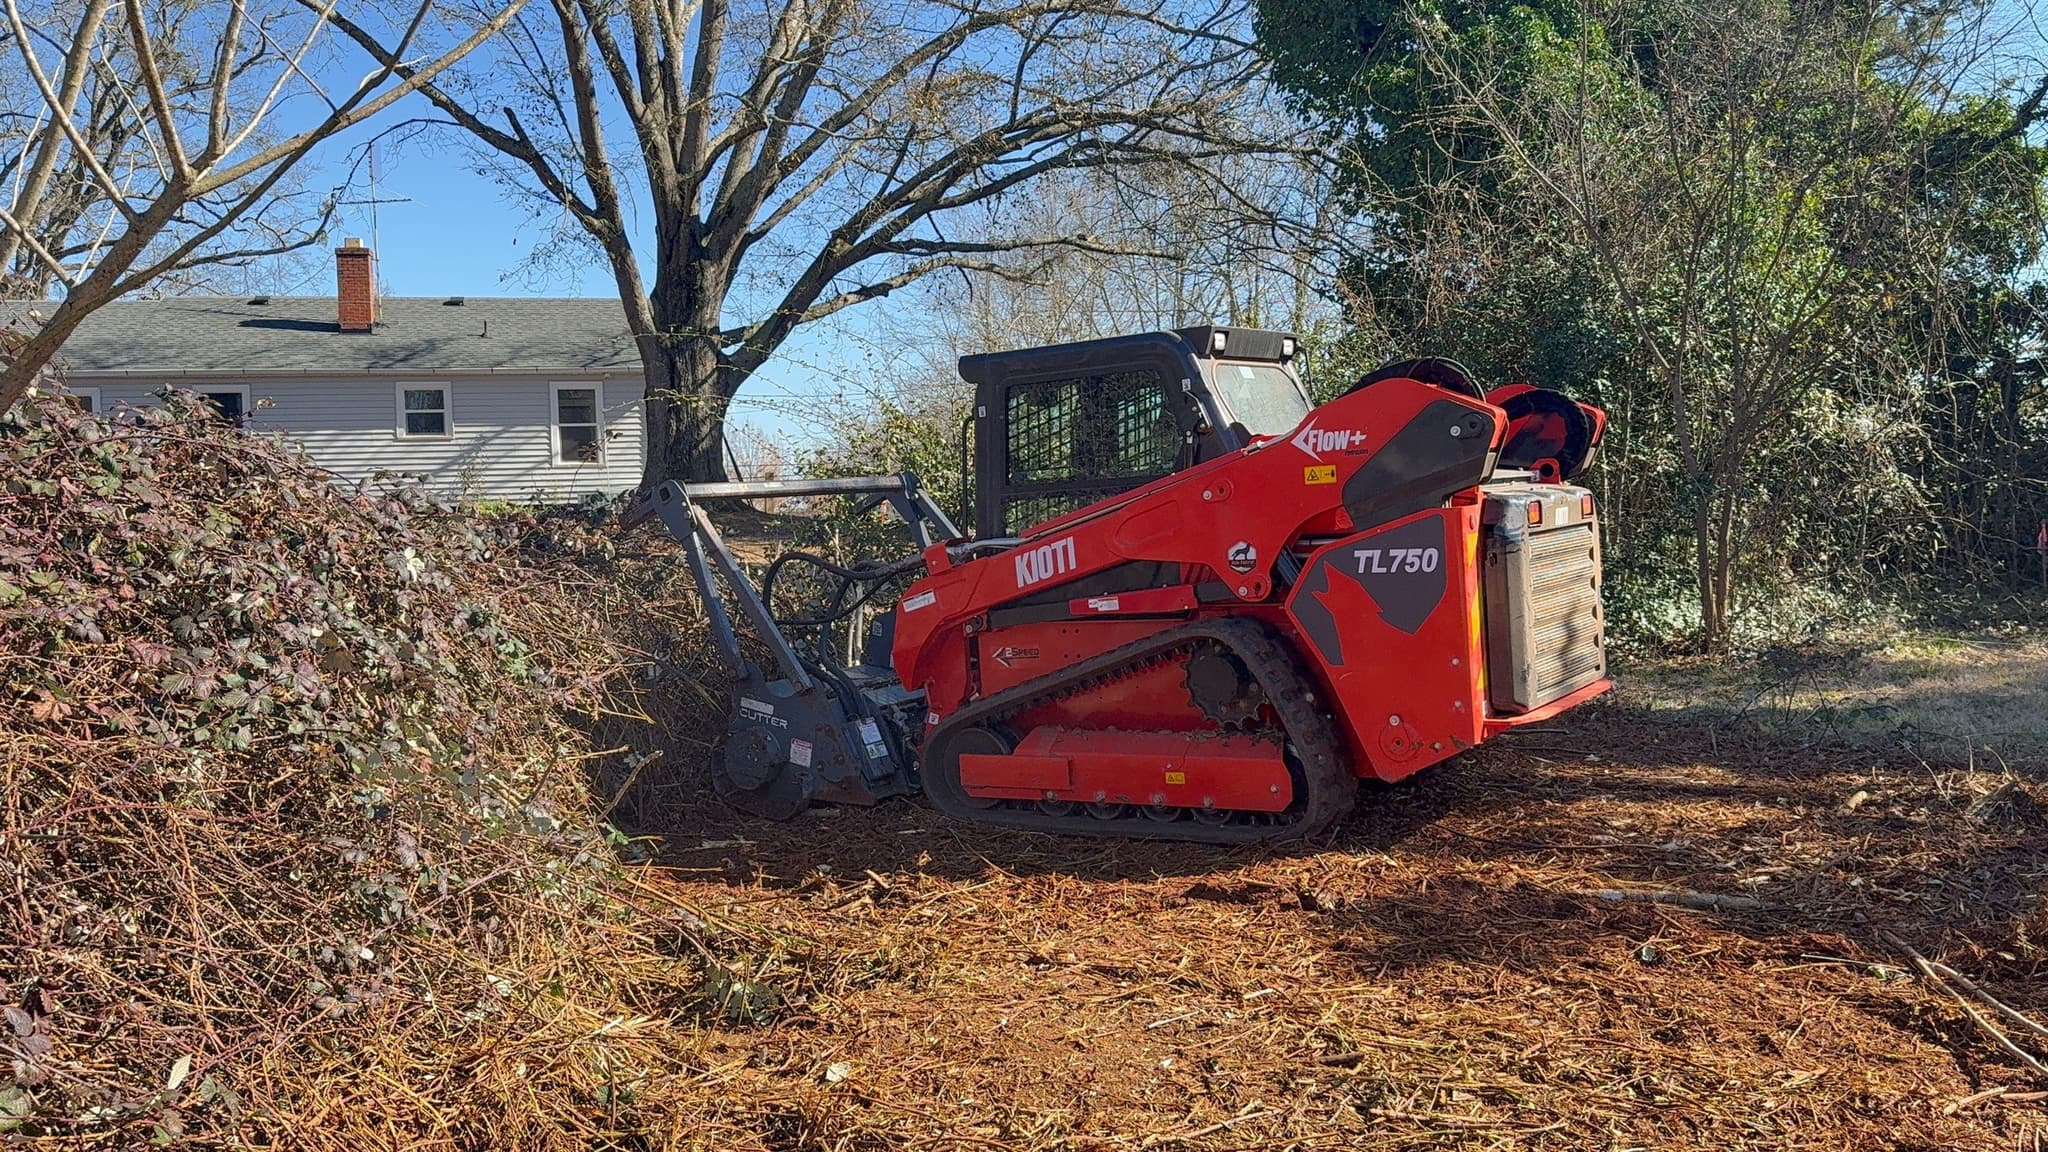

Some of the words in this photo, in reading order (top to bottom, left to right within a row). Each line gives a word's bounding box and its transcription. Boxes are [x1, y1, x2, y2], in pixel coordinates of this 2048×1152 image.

[1015, 537, 1077, 588] KIOTI
[1354, 547, 1439, 573] TL750
[739, 708, 788, 729] CUTTER
